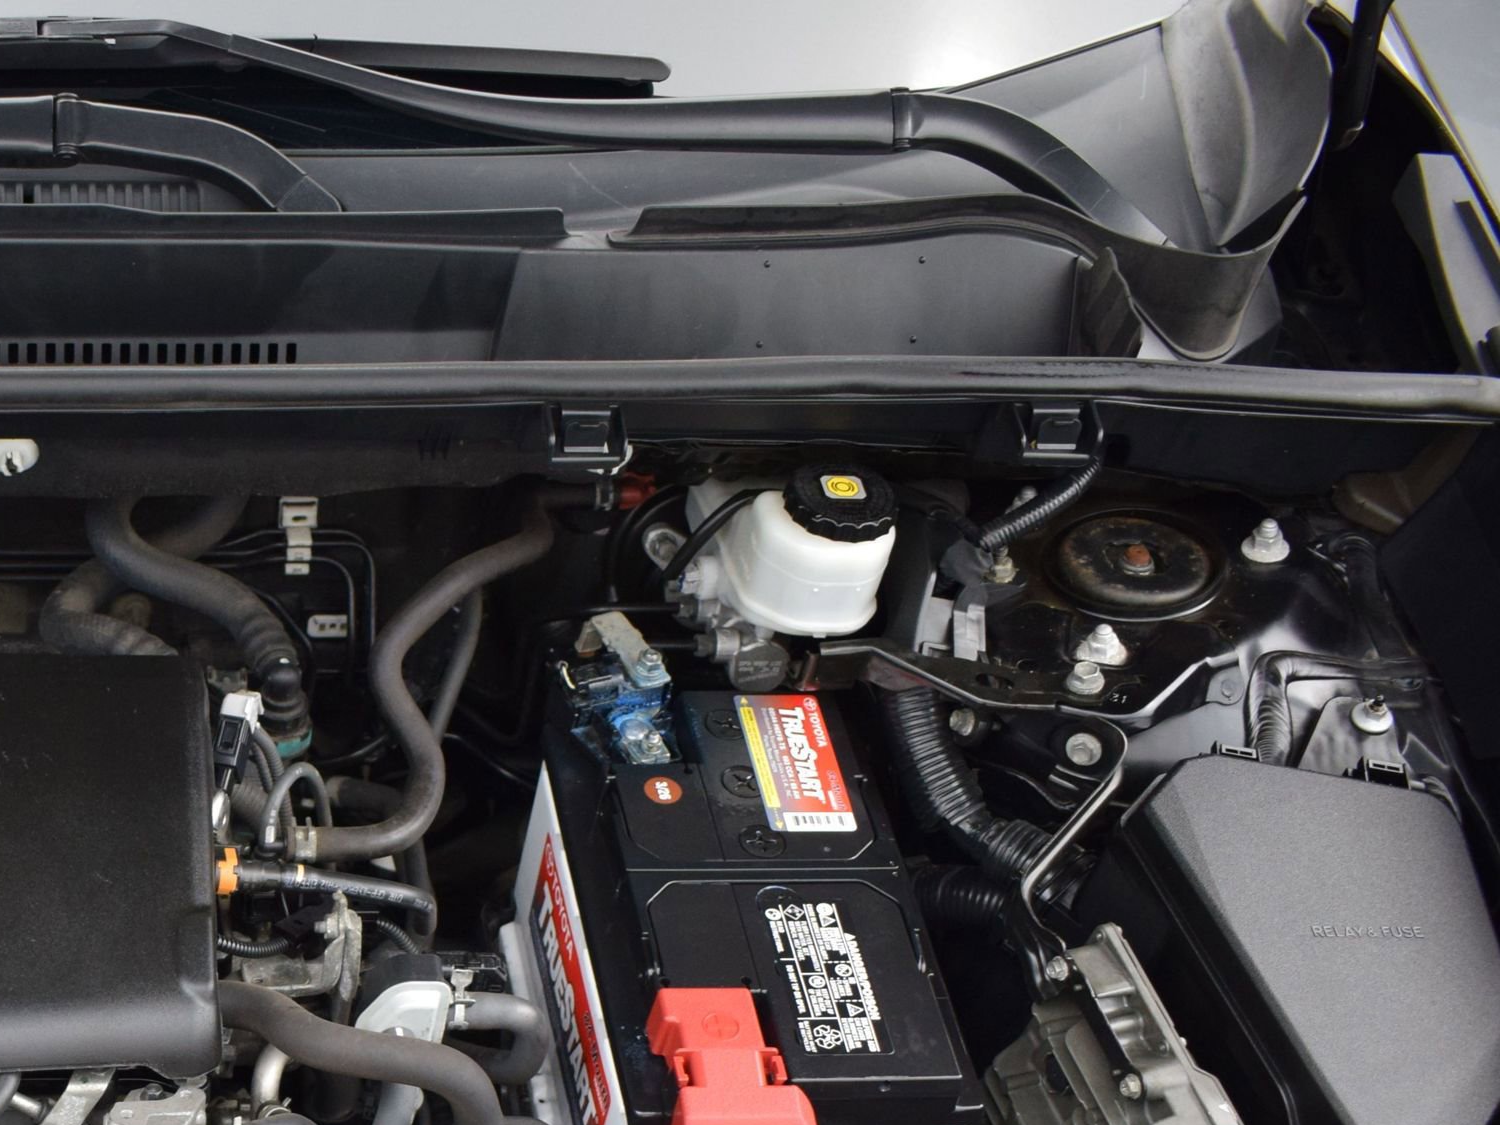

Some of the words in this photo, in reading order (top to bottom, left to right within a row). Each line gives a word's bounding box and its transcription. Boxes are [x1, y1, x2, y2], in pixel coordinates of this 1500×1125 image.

[809, 712, 828, 747] TOYOTA
[552, 880, 573, 960] TOYOTA
[1311, 925, 1362, 938] RELAY
[1367, 926, 1377, 937] &
[1380, 926, 1424, 939] FUSE
[851, 940, 881, 1020] DANGER/POISON
